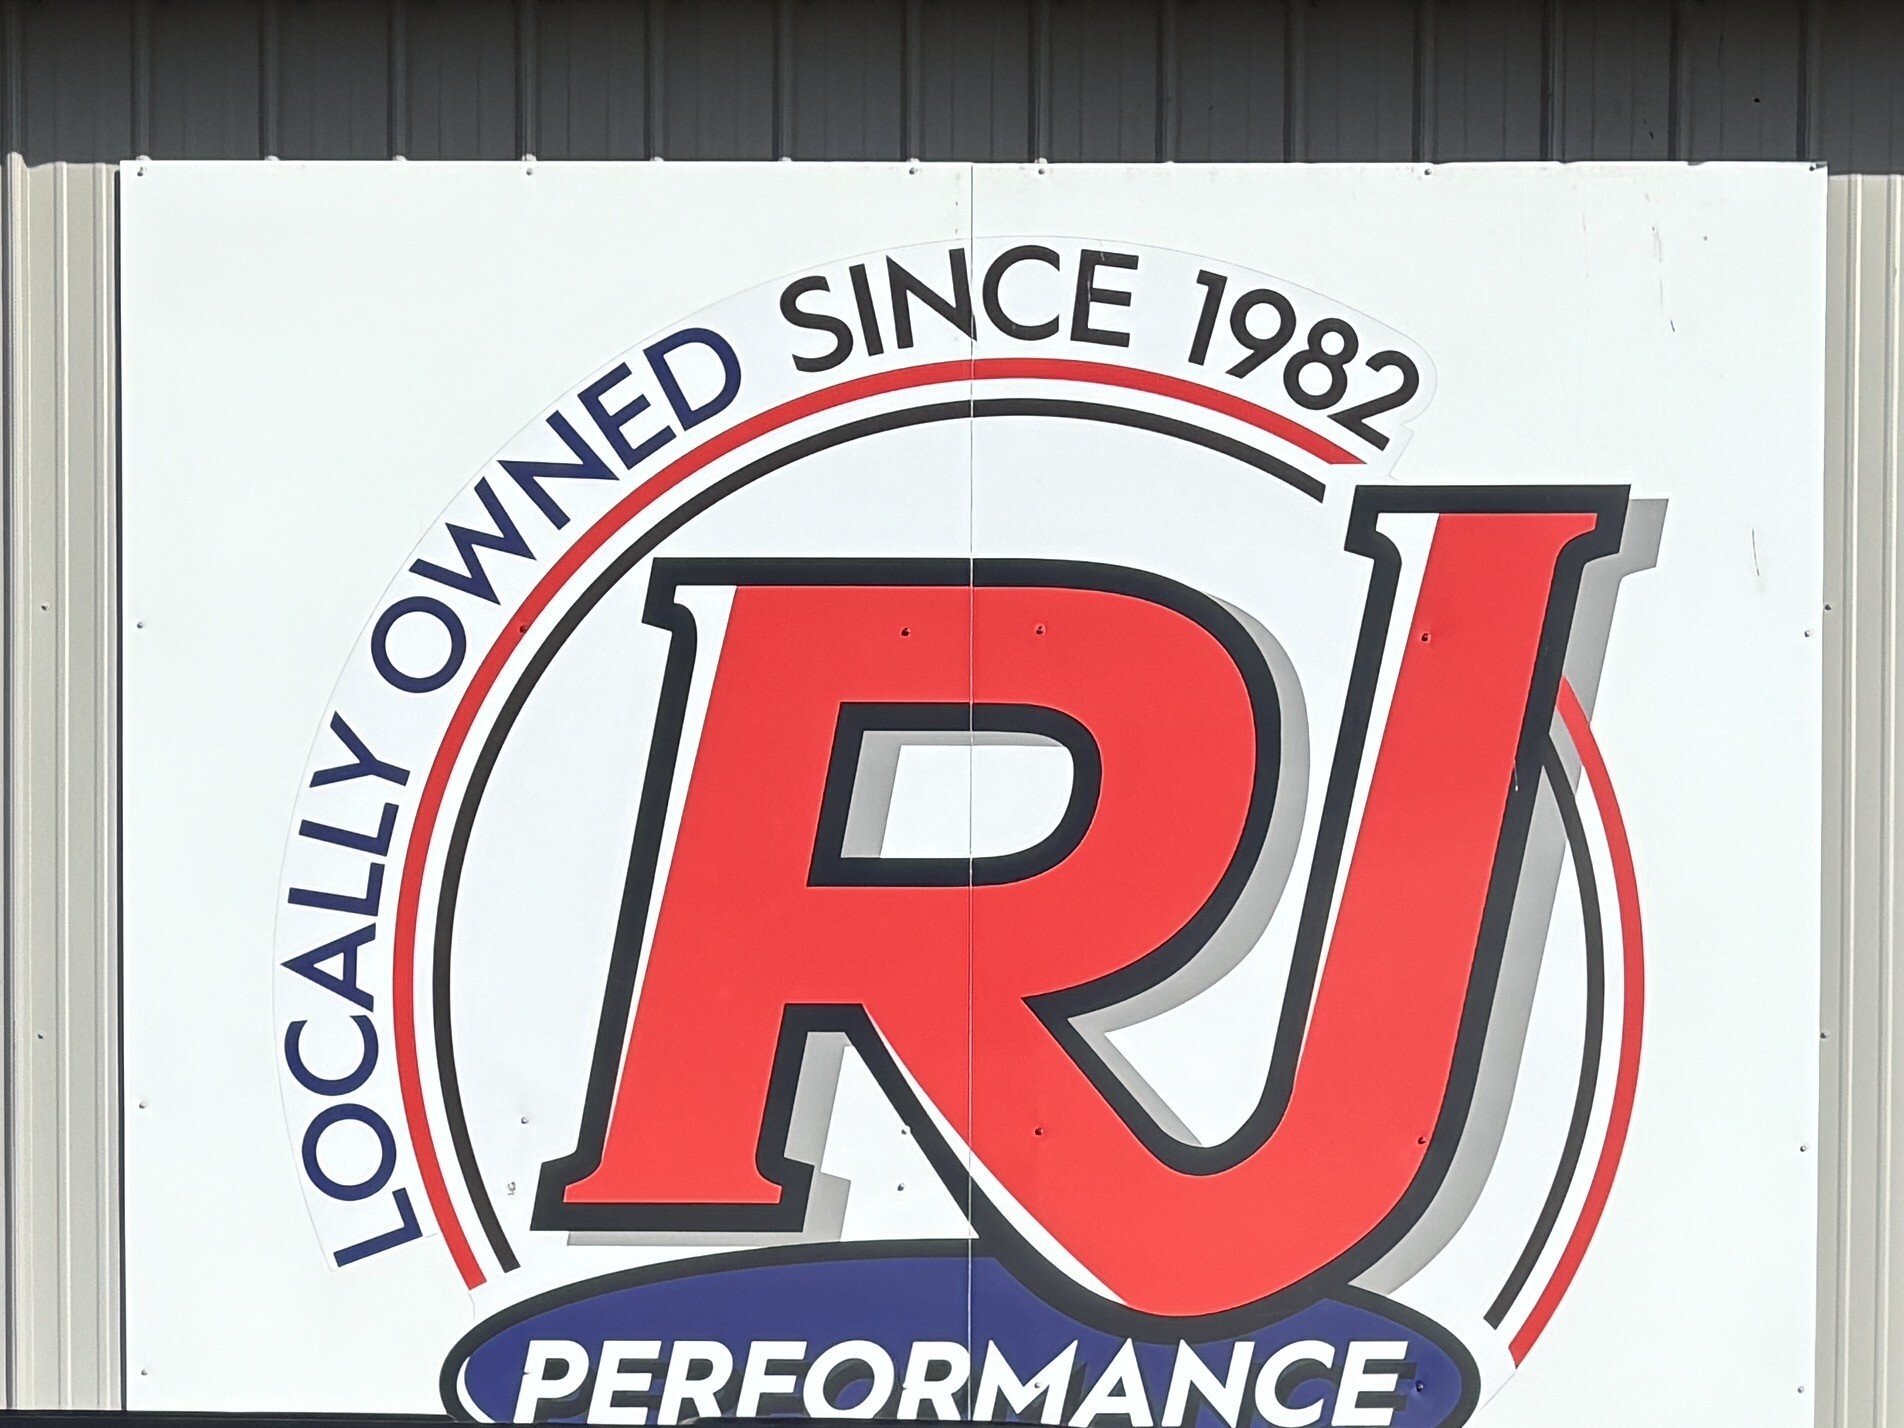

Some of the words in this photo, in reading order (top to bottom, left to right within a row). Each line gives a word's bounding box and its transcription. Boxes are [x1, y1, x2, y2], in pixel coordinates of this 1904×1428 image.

[280, 710, 423, 1267] LOCALLY
[370, 327, 743, 694] OWNED
[779, 244, 1139, 373] SINCE
[1187, 269, 1420, 452] 1982
[530, 484, 1632, 1346] RJ
